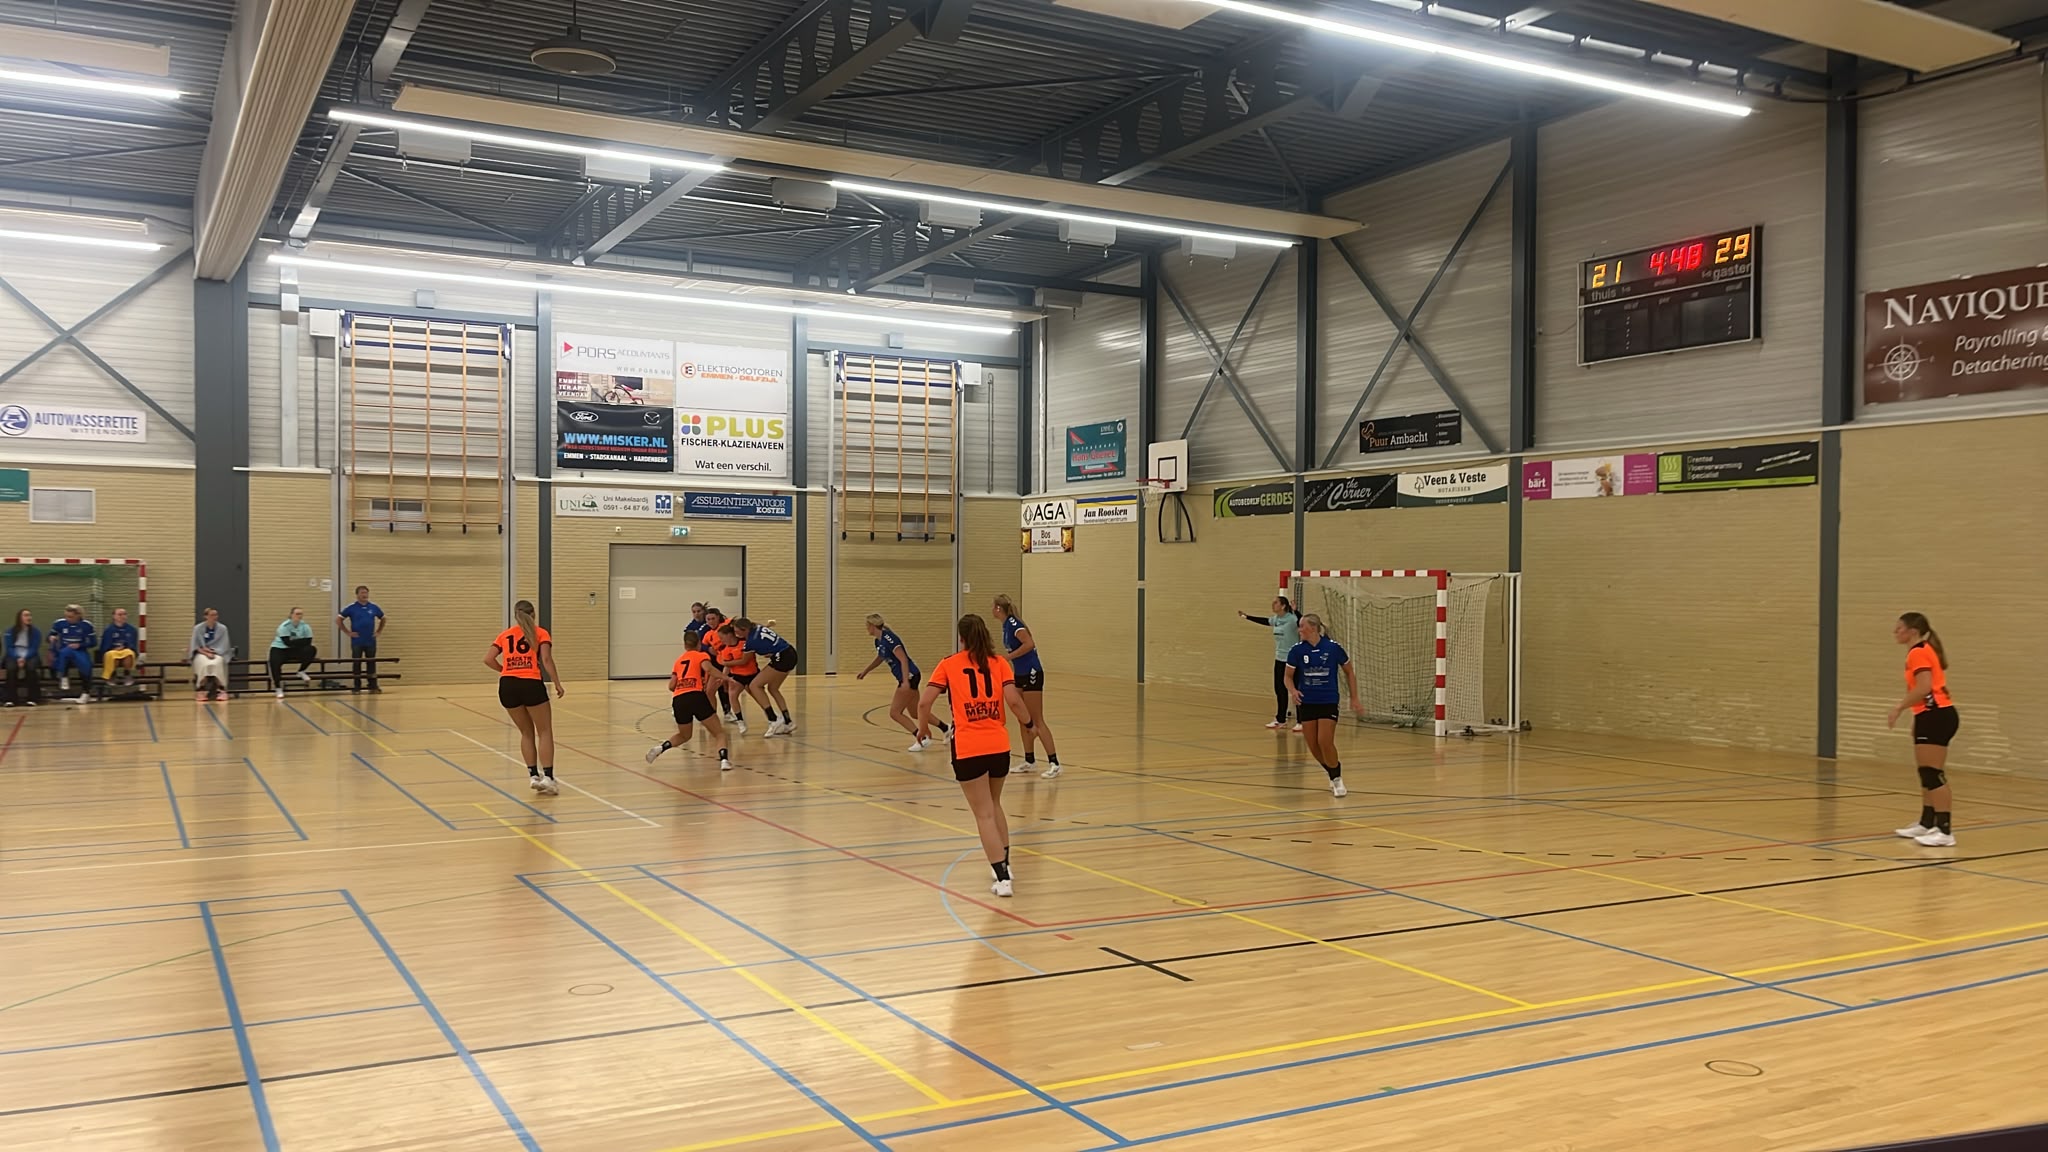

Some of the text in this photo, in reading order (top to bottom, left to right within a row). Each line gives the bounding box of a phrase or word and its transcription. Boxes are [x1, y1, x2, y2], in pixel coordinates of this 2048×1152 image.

[1592, 260, 1622, 289] 21
[1714, 233, 1750, 265] 29
[1592, 289, 1617, 302] thuis
[1954, 328, 2039, 354] Payrolling
[577, 346, 670, 361] PORS ACCOUNTANTS
[697, 364, 783, 377] ELEKTROMOTOREN
[1951, 352, 2048, 377] Detachering
[701, 372, 734, 380] EMMEN
[739, 375, 778, 383] DELFZIJL
[34, 412, 138, 430] AUTOWASSERETTE
[706, 416, 784, 440] PLUS
[564, 432, 668, 448] WWW.MISKER.NL
[681, 438, 784, 451] FISCHER-KLAZIENAVEEN
[1369, 438, 1389, 448] Puur
[1390, 431, 1428, 446] Ambacht
[589, 454, 628, 462] STADSKANAAL
[695, 460, 772, 472] Wat een verschil.
[1346, 478, 1359, 488] the
[1424, 472, 1487, 486] Veen & Veste
[615, 496, 649, 504] Makelaardij
[691, 496, 786, 508] ASSURANTIEKANTOOR
[1260, 492, 1293, 507] GERDES
[1326, 482, 1373, 510] Corner
[560, 499, 581, 511] UNI
[1033, 502, 1066, 521] AGA
[1084, 506, 1128, 518] Jan Roosken
[1041, 530, 1051, 539] Bos
[760, 626, 777, 642] 13
[505, 634, 531, 654] 16
[680, 659, 691, 678] 7
[963, 667, 993, 698] 11
[966, 707, 1000, 717] MEDIA
